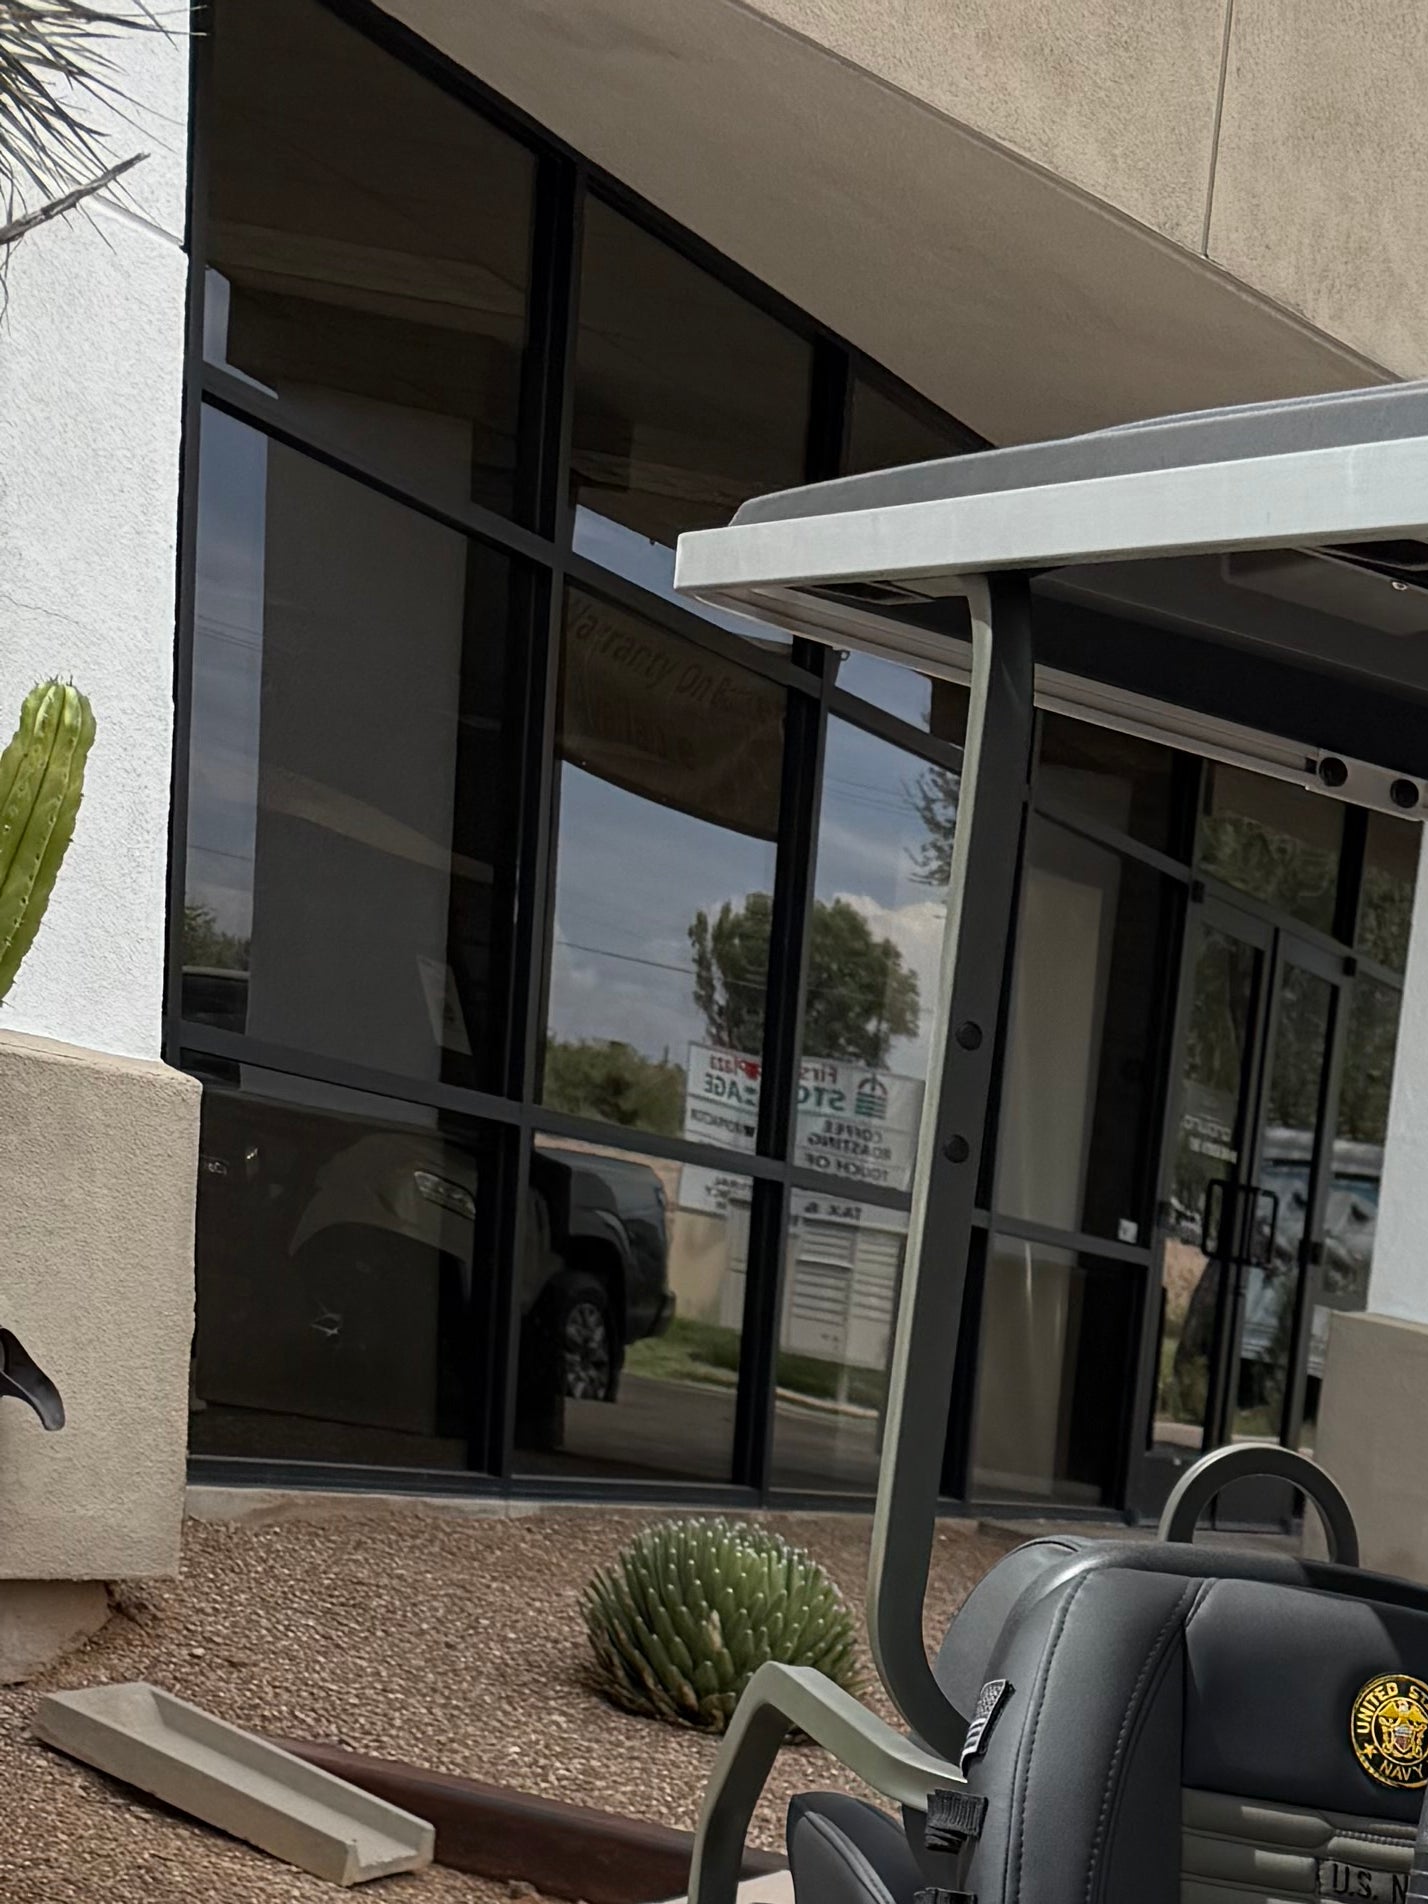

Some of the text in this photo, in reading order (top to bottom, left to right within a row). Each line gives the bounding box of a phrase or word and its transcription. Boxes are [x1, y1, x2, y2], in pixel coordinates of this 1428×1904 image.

[1356, 1682, 1398, 1734] UNITED
[1380, 1759, 1423, 1781] NAVY
[1332, 1863, 1379, 1901] U.S.
